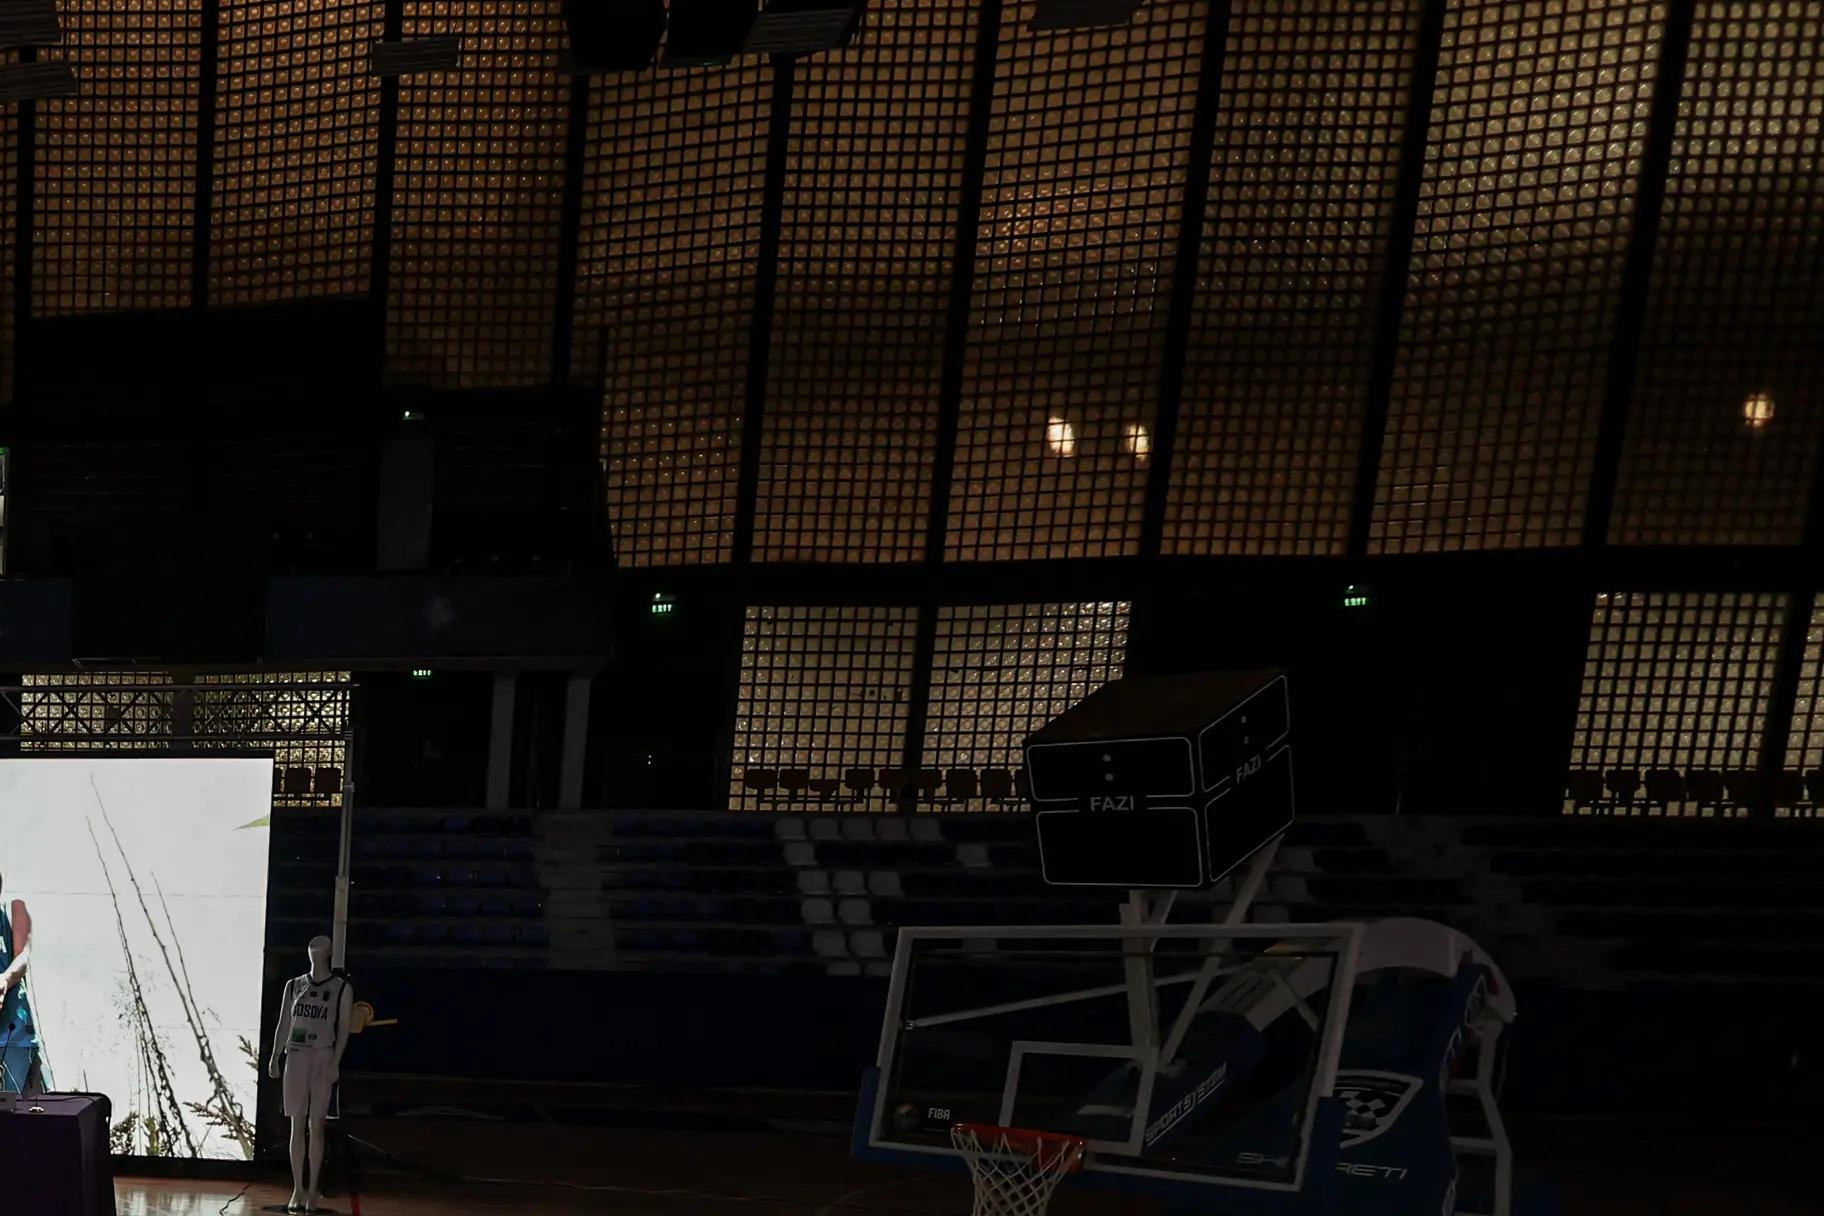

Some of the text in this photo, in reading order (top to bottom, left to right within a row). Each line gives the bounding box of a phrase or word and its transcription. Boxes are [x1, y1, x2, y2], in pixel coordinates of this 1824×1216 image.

[652, 604, 673, 614] EXIT
[1235, 753, 1261, 785] FAZI
[1089, 795, 1135, 812] FAZI
[928, 1107, 951, 1120] FIBA
